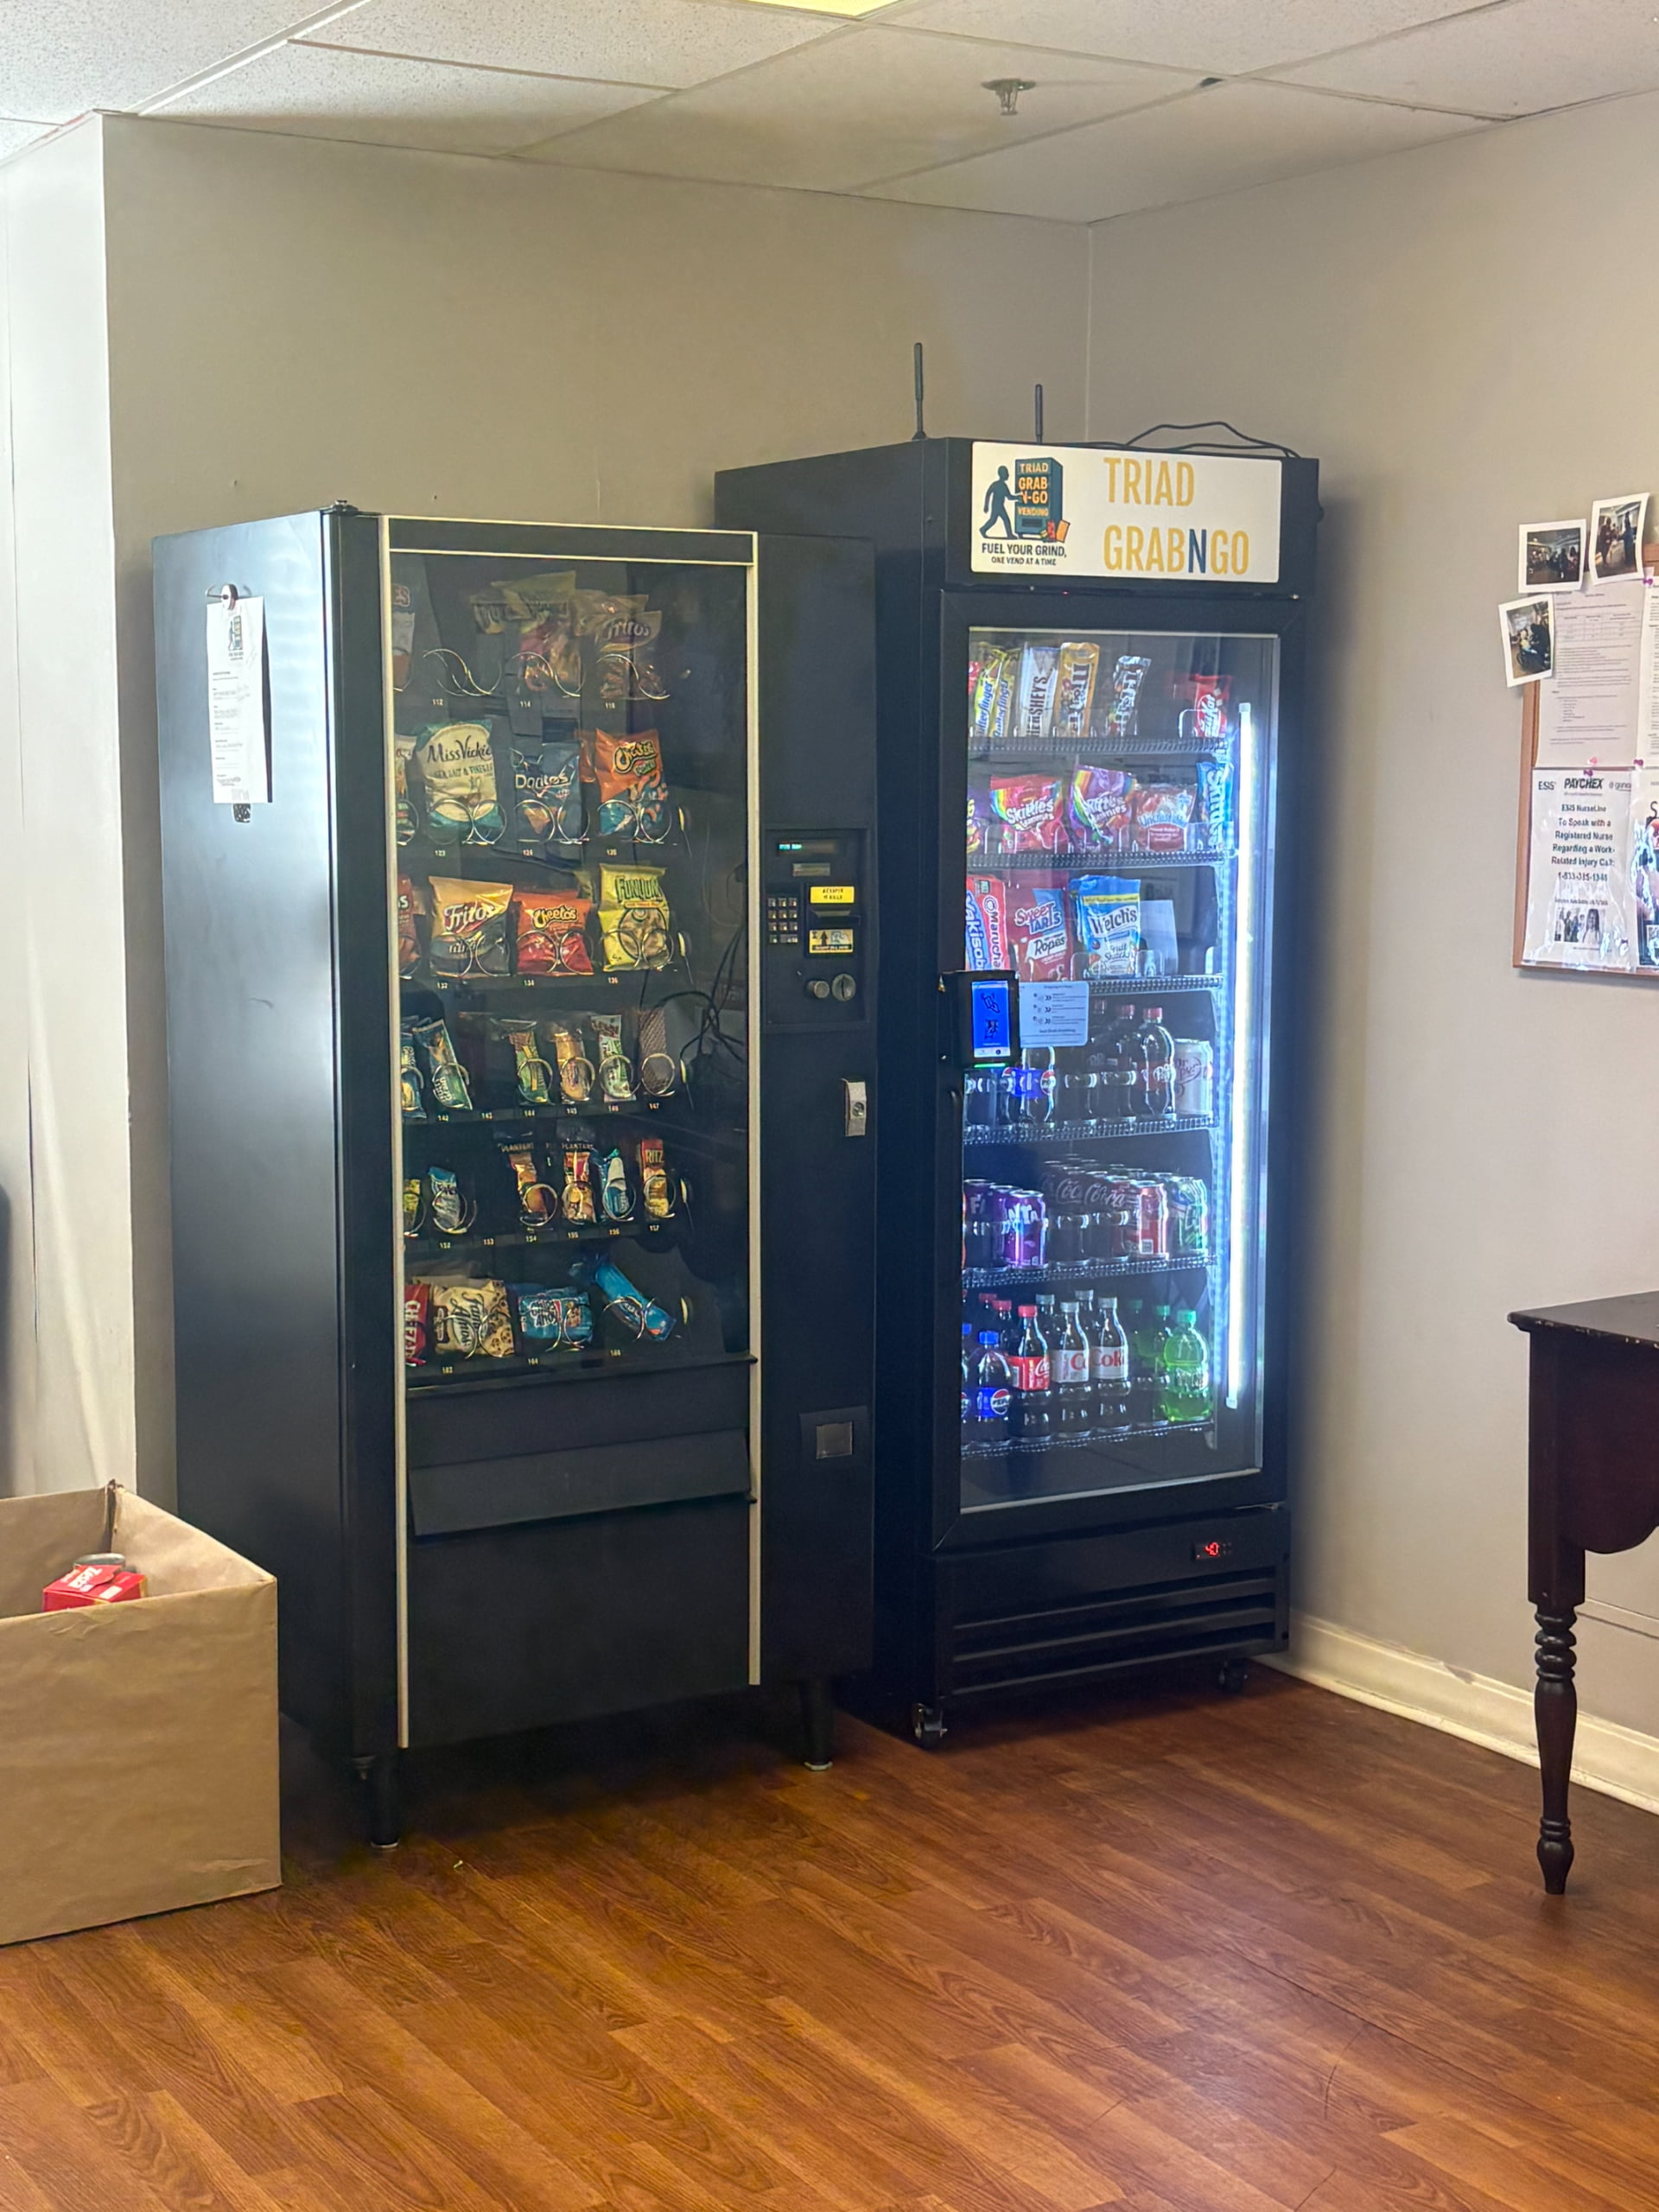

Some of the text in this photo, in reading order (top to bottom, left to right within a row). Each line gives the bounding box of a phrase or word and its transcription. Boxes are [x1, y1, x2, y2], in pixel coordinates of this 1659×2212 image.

[1020, 462, 1049, 474] TRIAD
[1018, 476, 1048, 491] GRAB
[1103, 457, 1195, 507] TRIAD
[1018, 506, 1049, 517] VENDING
[982, 543, 1067, 558] FUEL YOUR GRIND,
[1103, 524, 1249, 575] GRABNGO
[991, 556, 1005, 564] ONE
[1007, 556, 1025, 565] VEND
[515, 772, 569, 789] Doritos
[1564, 778, 1604, 790] PAYCHEX
[1006, 798, 1055, 824] Skittles
[1559, 817, 1567, 826] To
[1568, 817, 1589, 827] Speak
[1555, 830, 1613, 841] Registered Nurse
[1553, 843, 1587, 854] Regarding
[1551, 855, 1577, 865] Related
[1579, 857, 1598, 868] Injury
[443, 899, 495, 934] Fritos
[532, 906, 578, 929] Cheetos
[1090, 907, 1138, 935] Welch's
[965, 891, 987, 971] Yakisob
[988, 911, 1002, 969] Marucha
[1033, 937, 1065, 957] Ropes
[645, 1150, 664, 1164] RITZ
[1091, 1348, 1123, 1368] Cok
